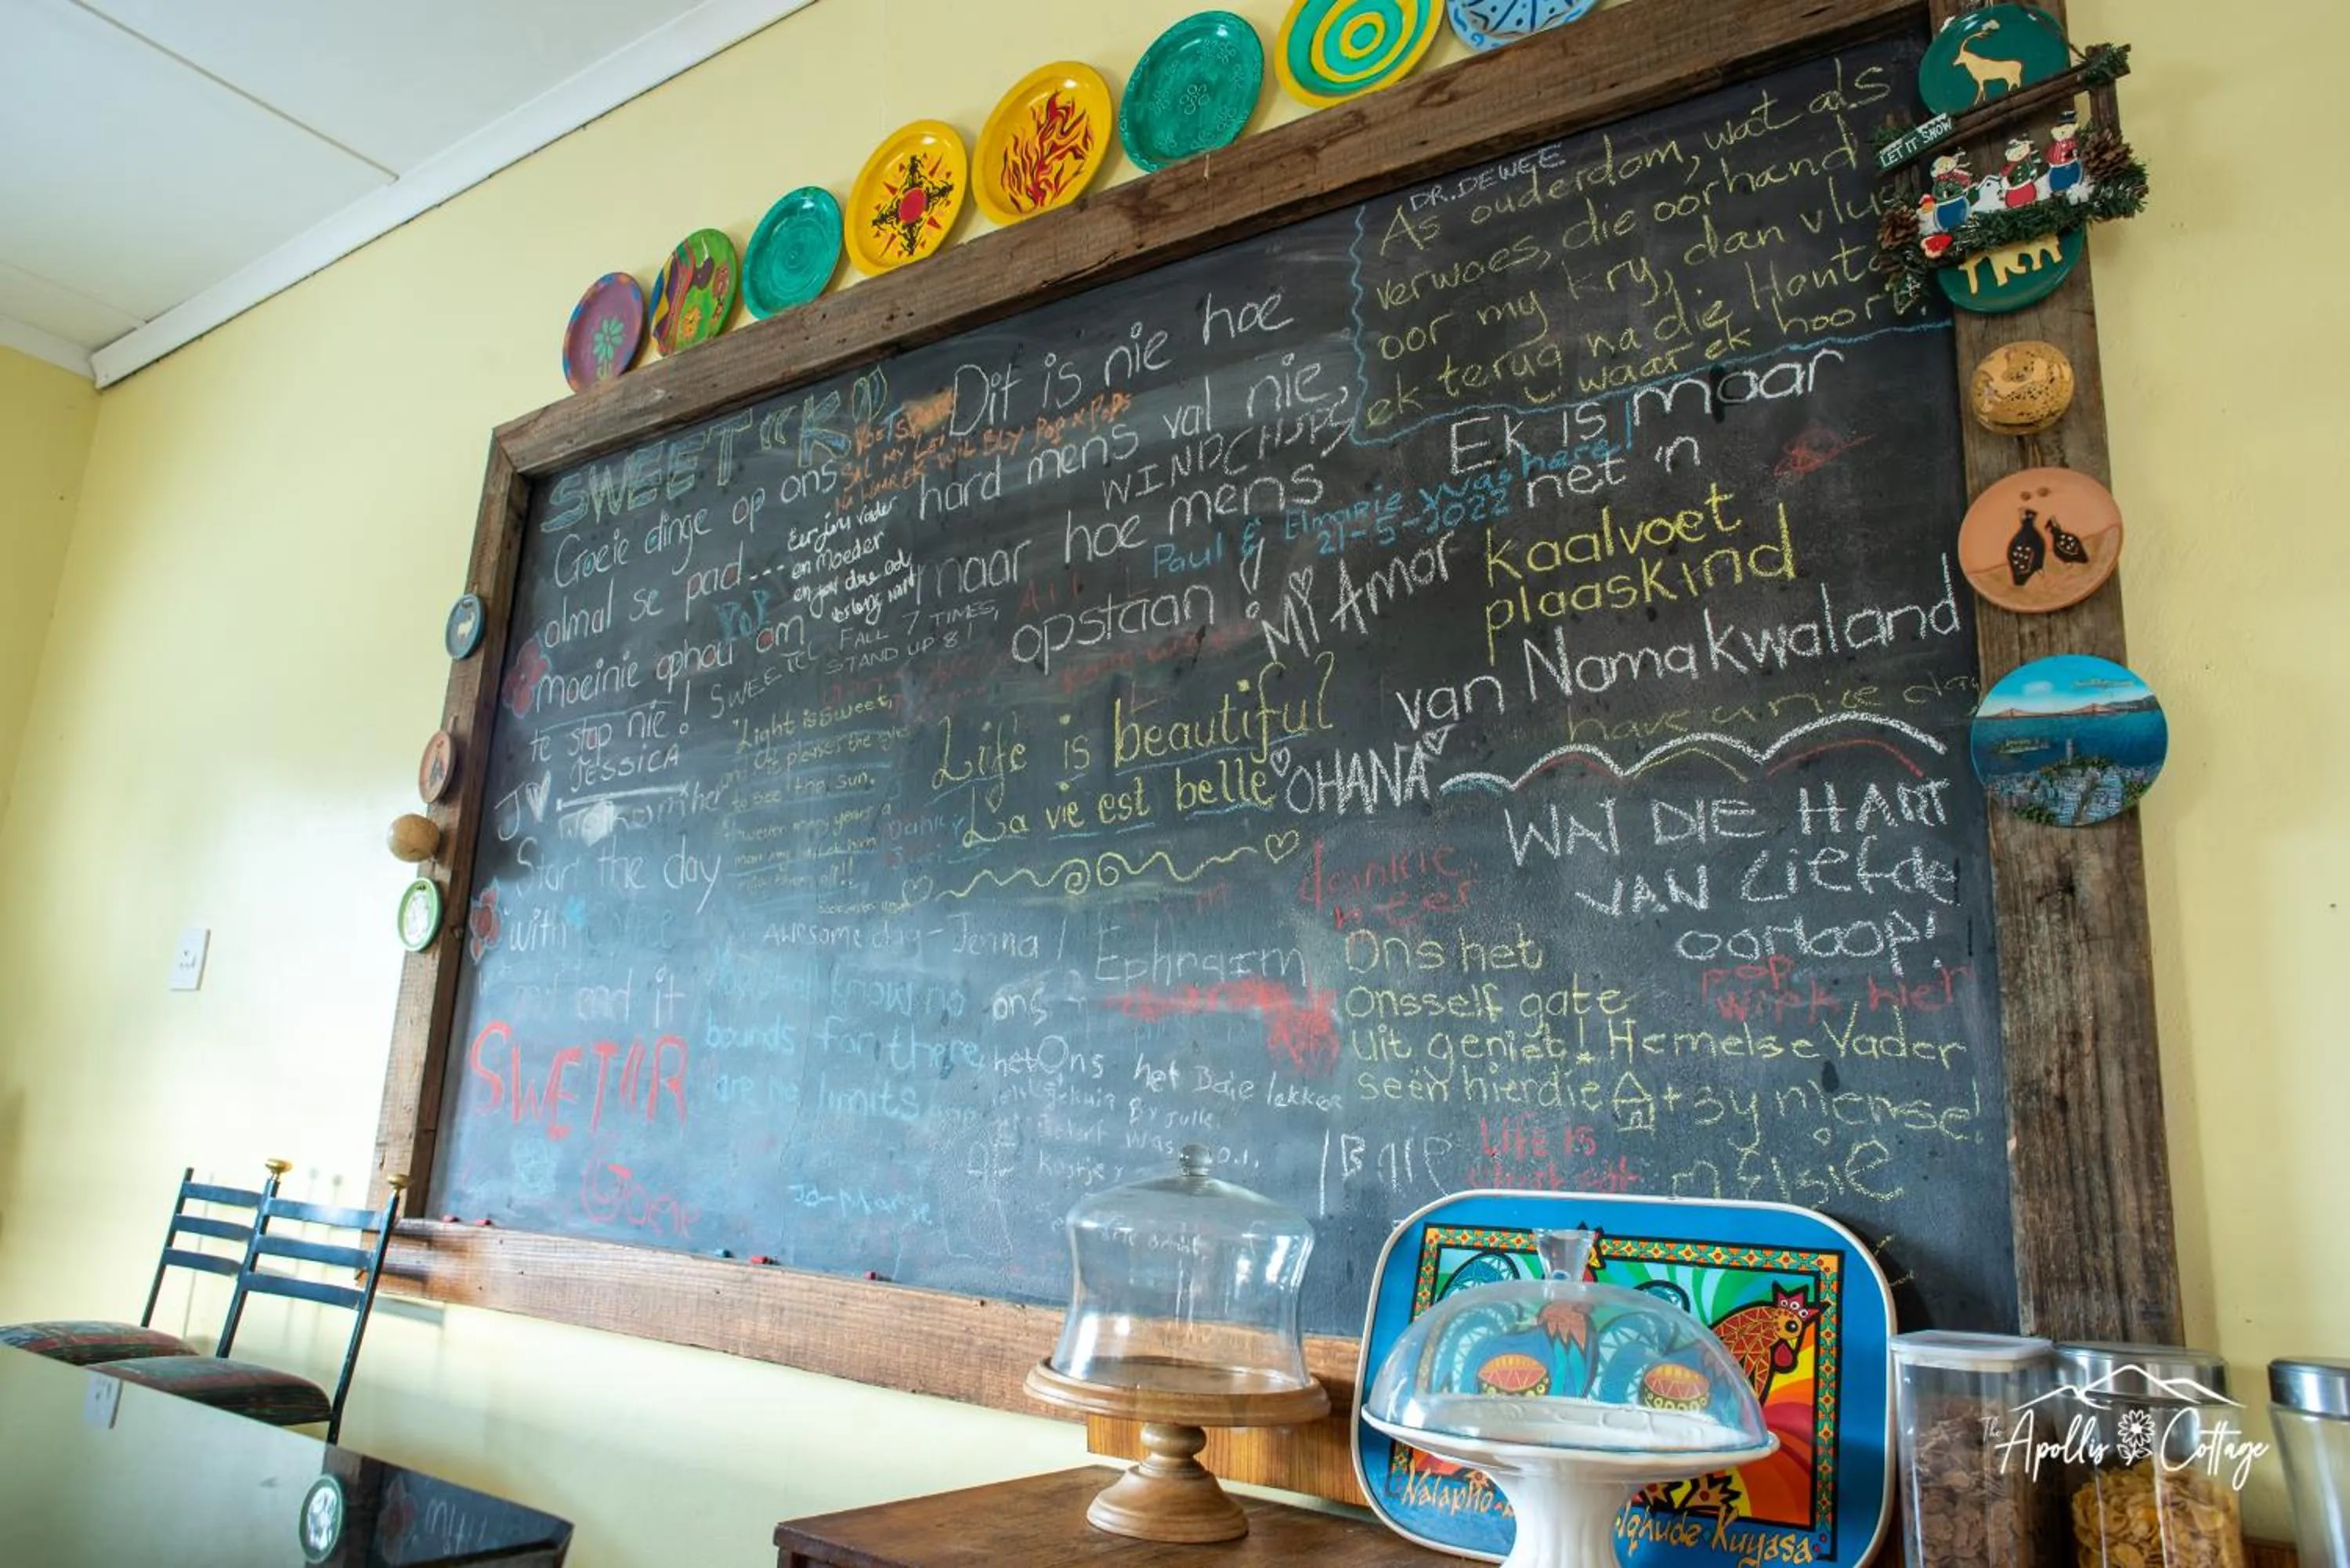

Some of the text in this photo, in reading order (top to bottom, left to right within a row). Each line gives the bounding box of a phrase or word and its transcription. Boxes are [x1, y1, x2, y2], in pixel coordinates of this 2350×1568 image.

[1880, 117, 1952, 168] LET IT SNOW
[1379, 204, 1441, 256] As
[1562, 197, 1636, 248] die
[1378, 313, 1455, 360] oor
[1477, 290, 1549, 349] my
[1684, 215, 1785, 266] dan
[949, 363, 1022, 436] Dit
[1043, 352, 1083, 410] is
[1104, 321, 1173, 387] nie
[1202, 292, 1294, 345] hoe
[1367, 372, 1424, 428] ek
[1587, 327, 1643, 358] na
[1654, 274, 1725, 341] die
[1704, 309, 1752, 360] ek
[1449, 412, 1526, 475] Ek
[1633, 347, 1845, 426] maar
[918, 454, 1002, 521] hard
[1027, 423, 1139, 486] mens
[1163, 376, 1213, 439] val
[1526, 456, 1627, 509] net
[645, 508, 712, 575] dinge
[732, 487, 767, 533] op
[780, 458, 840, 504] ons
[1064, 509, 1149, 565] hoe
[1169, 462, 1325, 537] mens
[1154, 533, 1225, 580] Paul
[629, 588, 663, 621] se
[841, 629, 888, 649] FALL
[826, 648, 898, 674] STAND
[1395, 551, 1961, 731] van Namakwaland
[931, 710, 1027, 813] Life
[1059, 713, 1091, 771] is
[1113, 650, 1334, 769] beautiful
[962, 786, 1030, 849] La
[1097, 775, 1151, 826] est
[1175, 758, 1277, 813] belle
[1651, 798, 1766, 846] DIE
[598, 835, 649, 891] the
[663, 833, 721, 916] day
[1344, 923, 1544, 974] Ons het
[1821, 999, 1968, 1071] Vader
